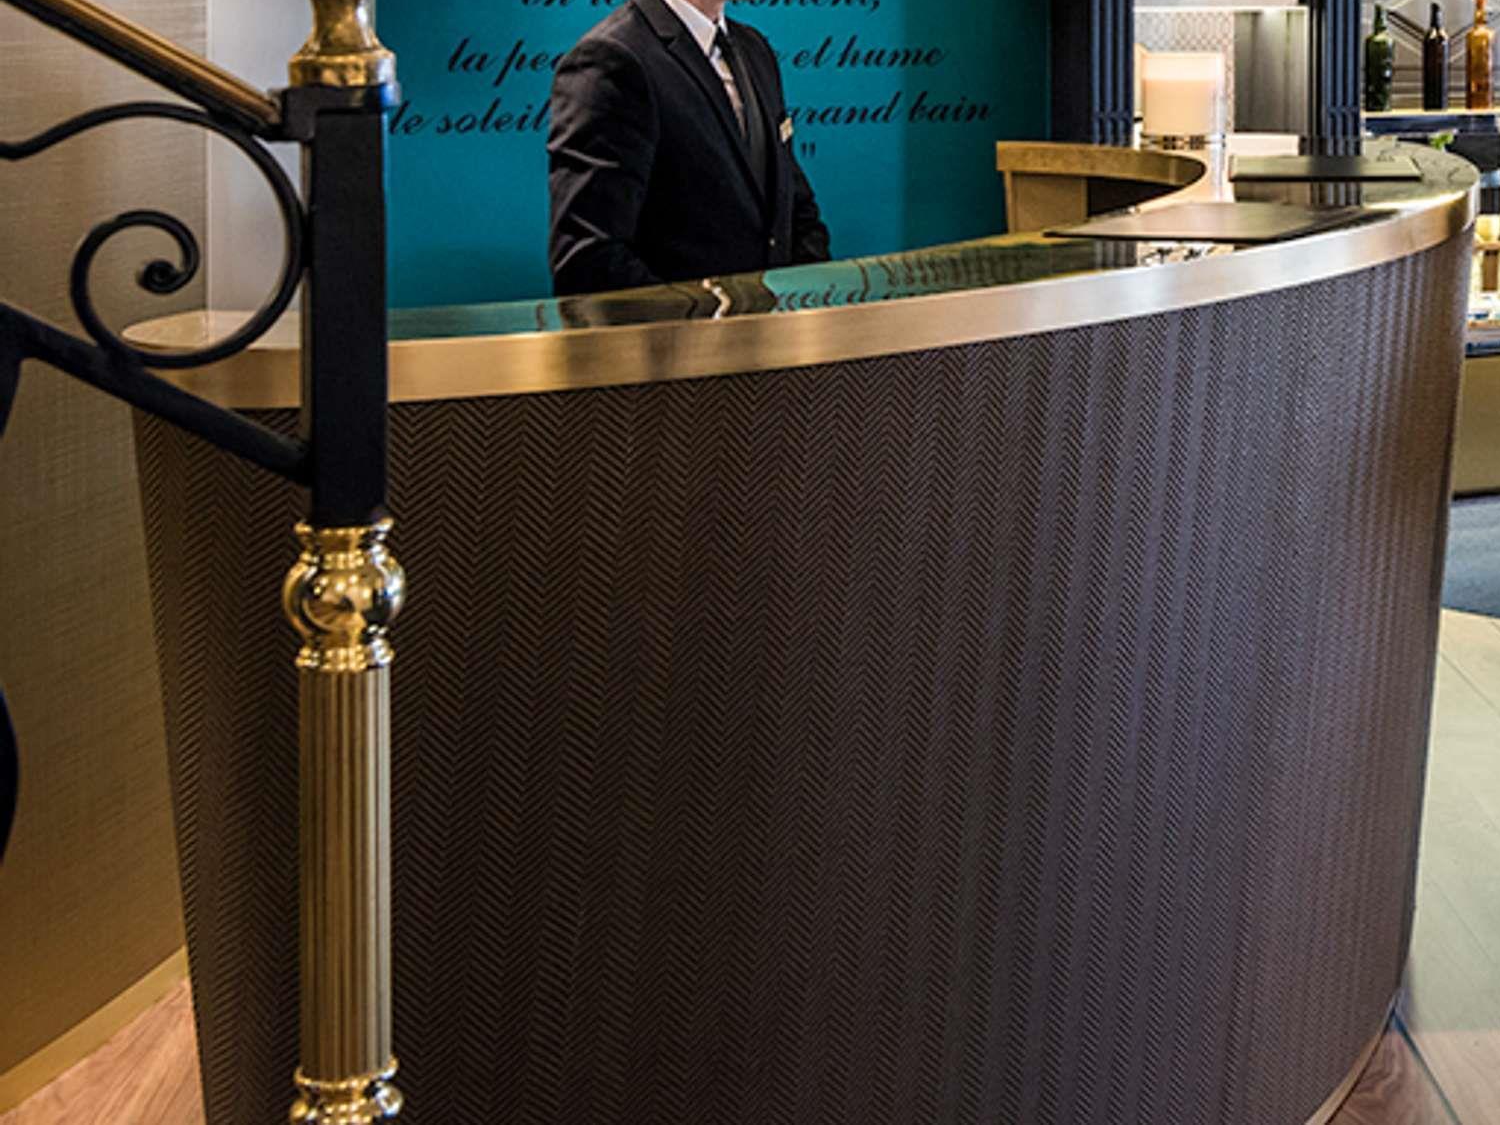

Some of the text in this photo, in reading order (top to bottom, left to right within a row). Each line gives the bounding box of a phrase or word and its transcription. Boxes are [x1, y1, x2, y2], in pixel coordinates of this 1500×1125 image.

[448, 36, 493, 73] la
[793, 35, 834, 69] et
[837, 35, 948, 69] hume
[436, 97, 552, 134] soleil
[907, 90, 990, 124] bain
